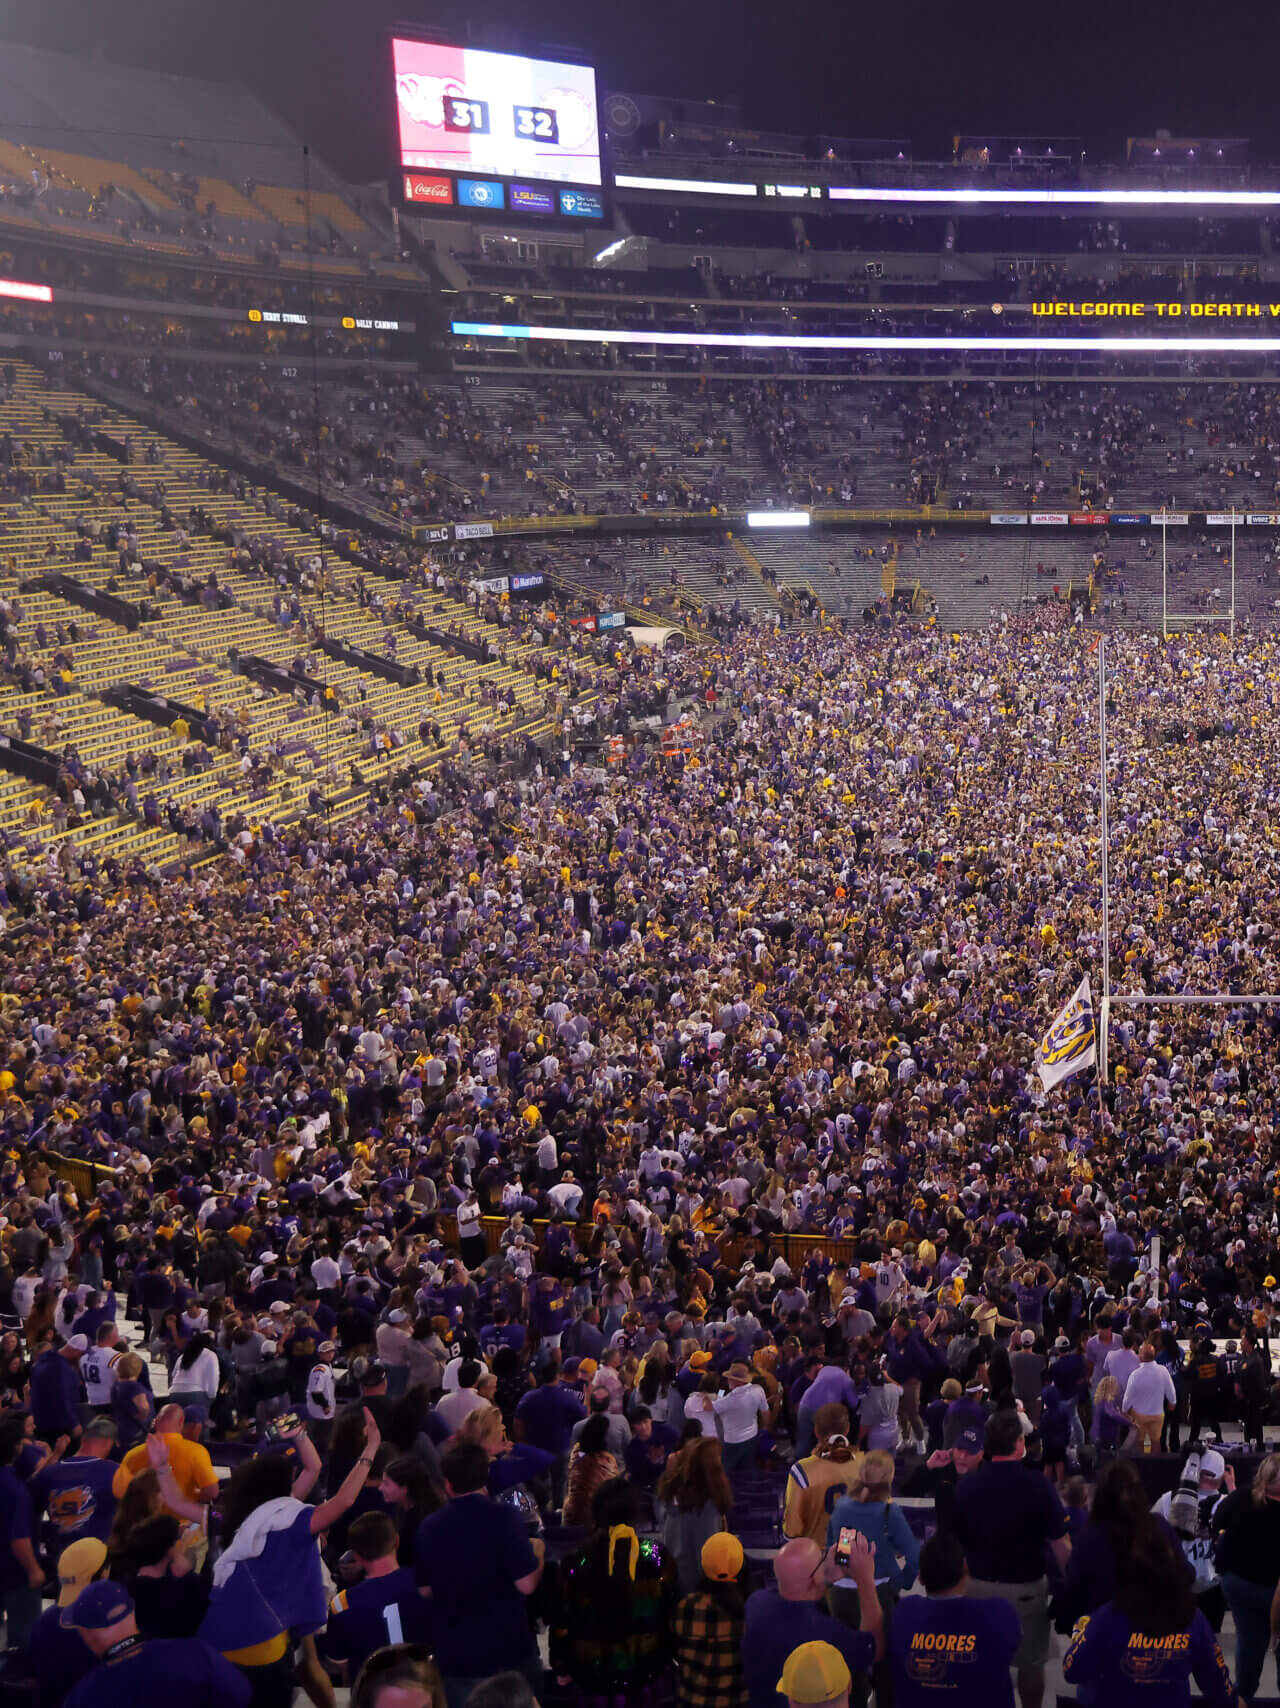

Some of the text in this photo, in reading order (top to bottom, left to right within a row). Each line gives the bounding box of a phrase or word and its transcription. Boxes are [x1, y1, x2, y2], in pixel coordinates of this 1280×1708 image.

[451, 101, 483, 129] 31
[517, 111, 554, 137] 32
[513, 191, 535, 202] LSU
[1032, 302, 1145, 316] WELCOME
[1154, 303, 1182, 316] TO
[1190, 303, 1261, 317] DEATH
[374, 320, 399, 330] CANNON
[465, 526, 490, 537] TACO BELL
[519, 575, 544, 588] Marathon
[484, 1055, 497, 1067] 22
[839, 1121, 846, 1134] 3
[880, 1272, 889, 1286] 10
[83, 1363, 101, 1384] 18
[383, 1602, 404, 1645] 1
[910, 1632, 977, 1652] MOORES
[1127, 1632, 1191, 1650] MOORES
